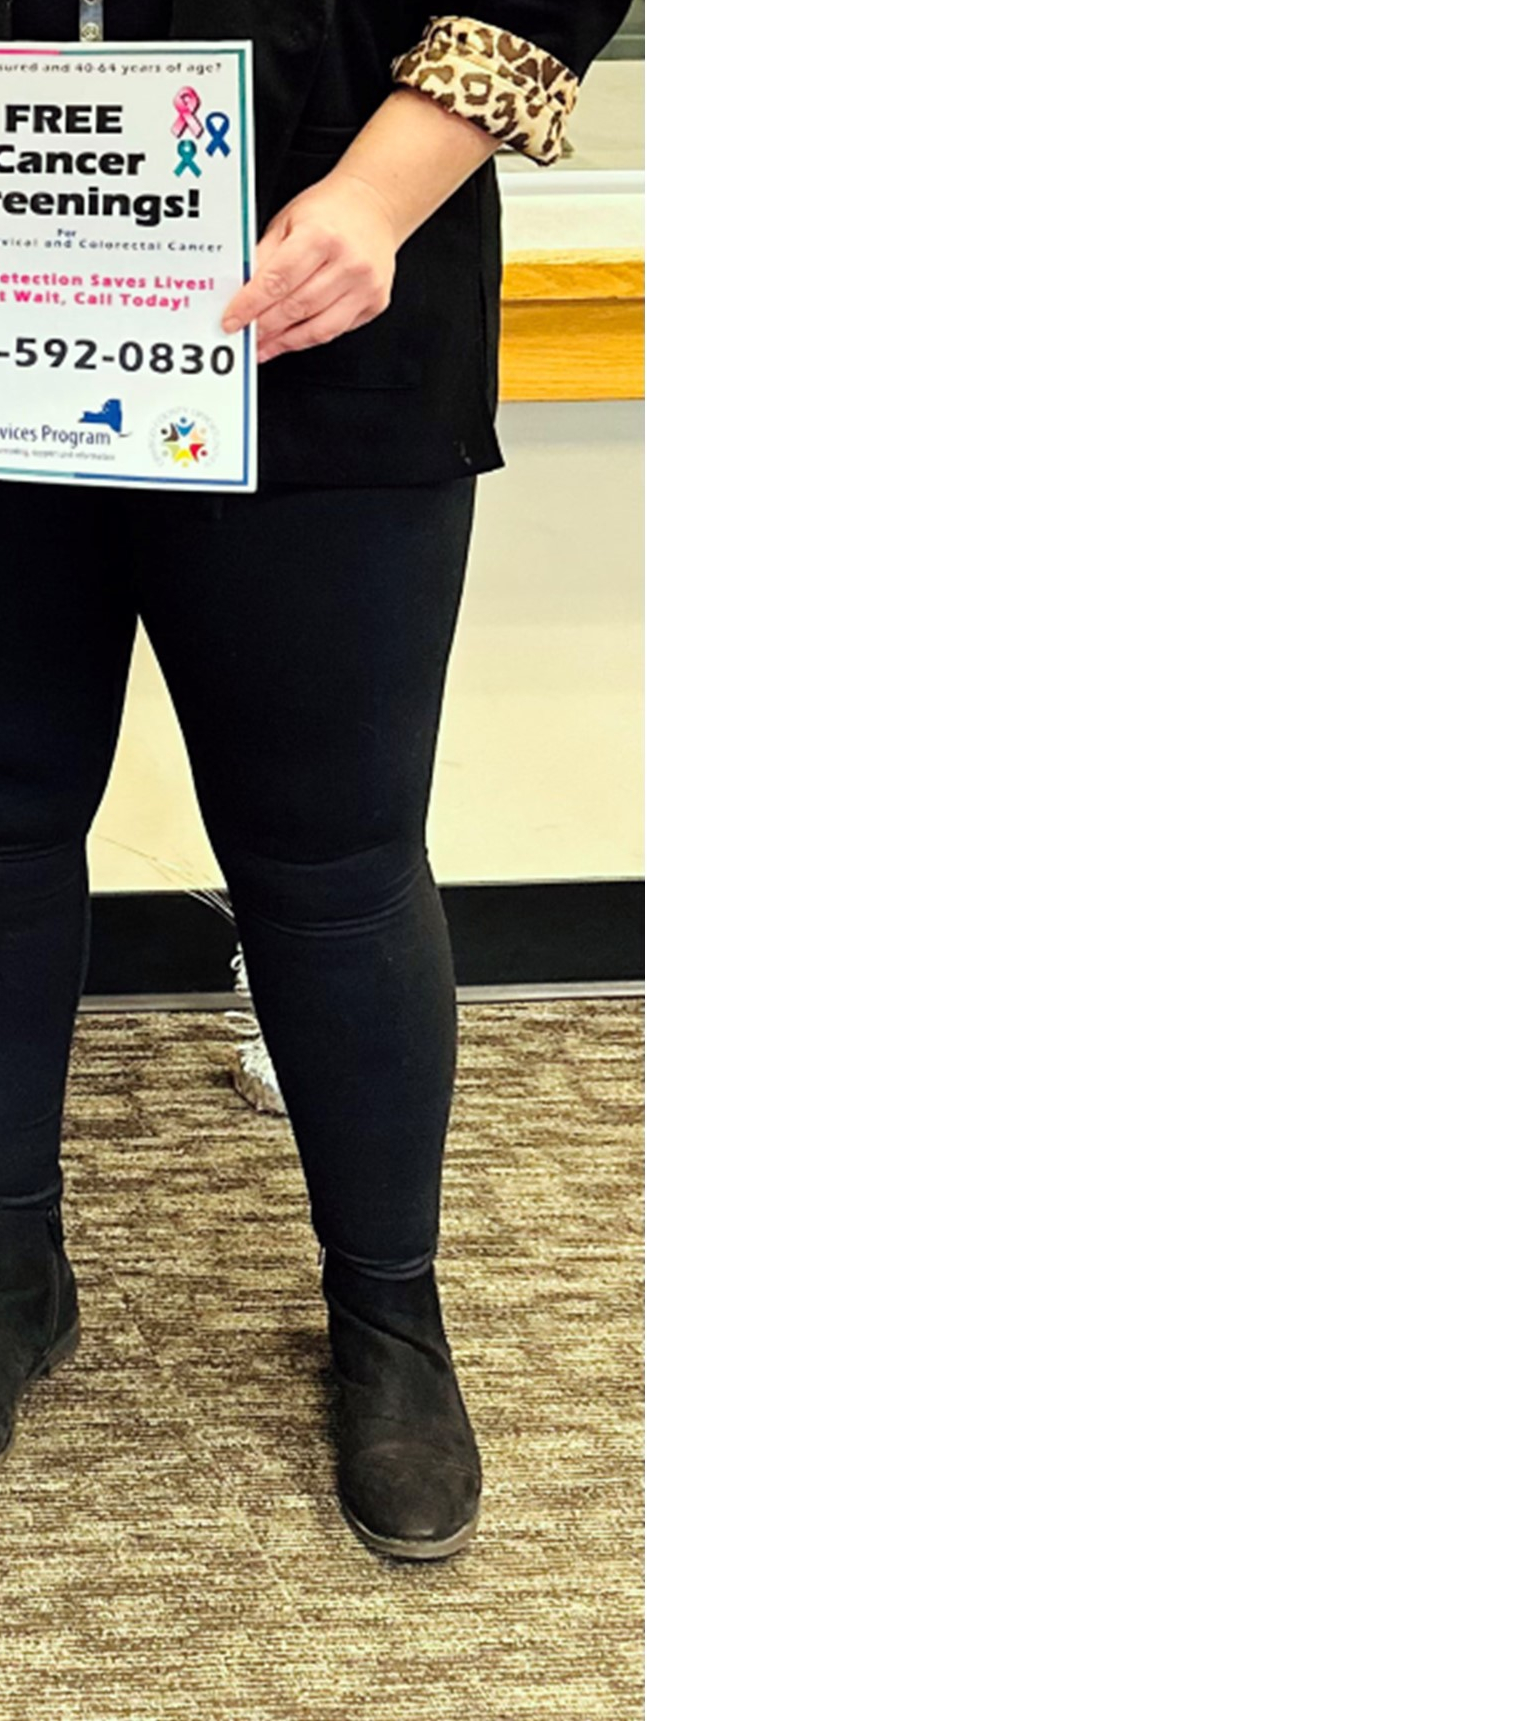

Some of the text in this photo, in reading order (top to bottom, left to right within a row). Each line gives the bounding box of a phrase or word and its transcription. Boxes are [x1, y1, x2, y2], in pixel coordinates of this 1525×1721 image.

[42, 63, 70, 74] and
[120, 63, 162, 76] years
[165, 62, 182, 74] of
[185, 62, 223, 76] age?
[3, 104, 124, 135] FREE
[56, 228, 77, 238] For
[44, 239, 73, 250] and
[78, 239, 162, 252] Colorectal
[167, 241, 223, 254] Cancer
[90, 273, 147, 289] Saves
[153, 275, 215, 292] Lives!
[13, 290, 67, 307] Wait,
[73, 291, 113, 306] Call
[119, 293, 191, 312] Today!
[41, 424, 112, 450] Program
